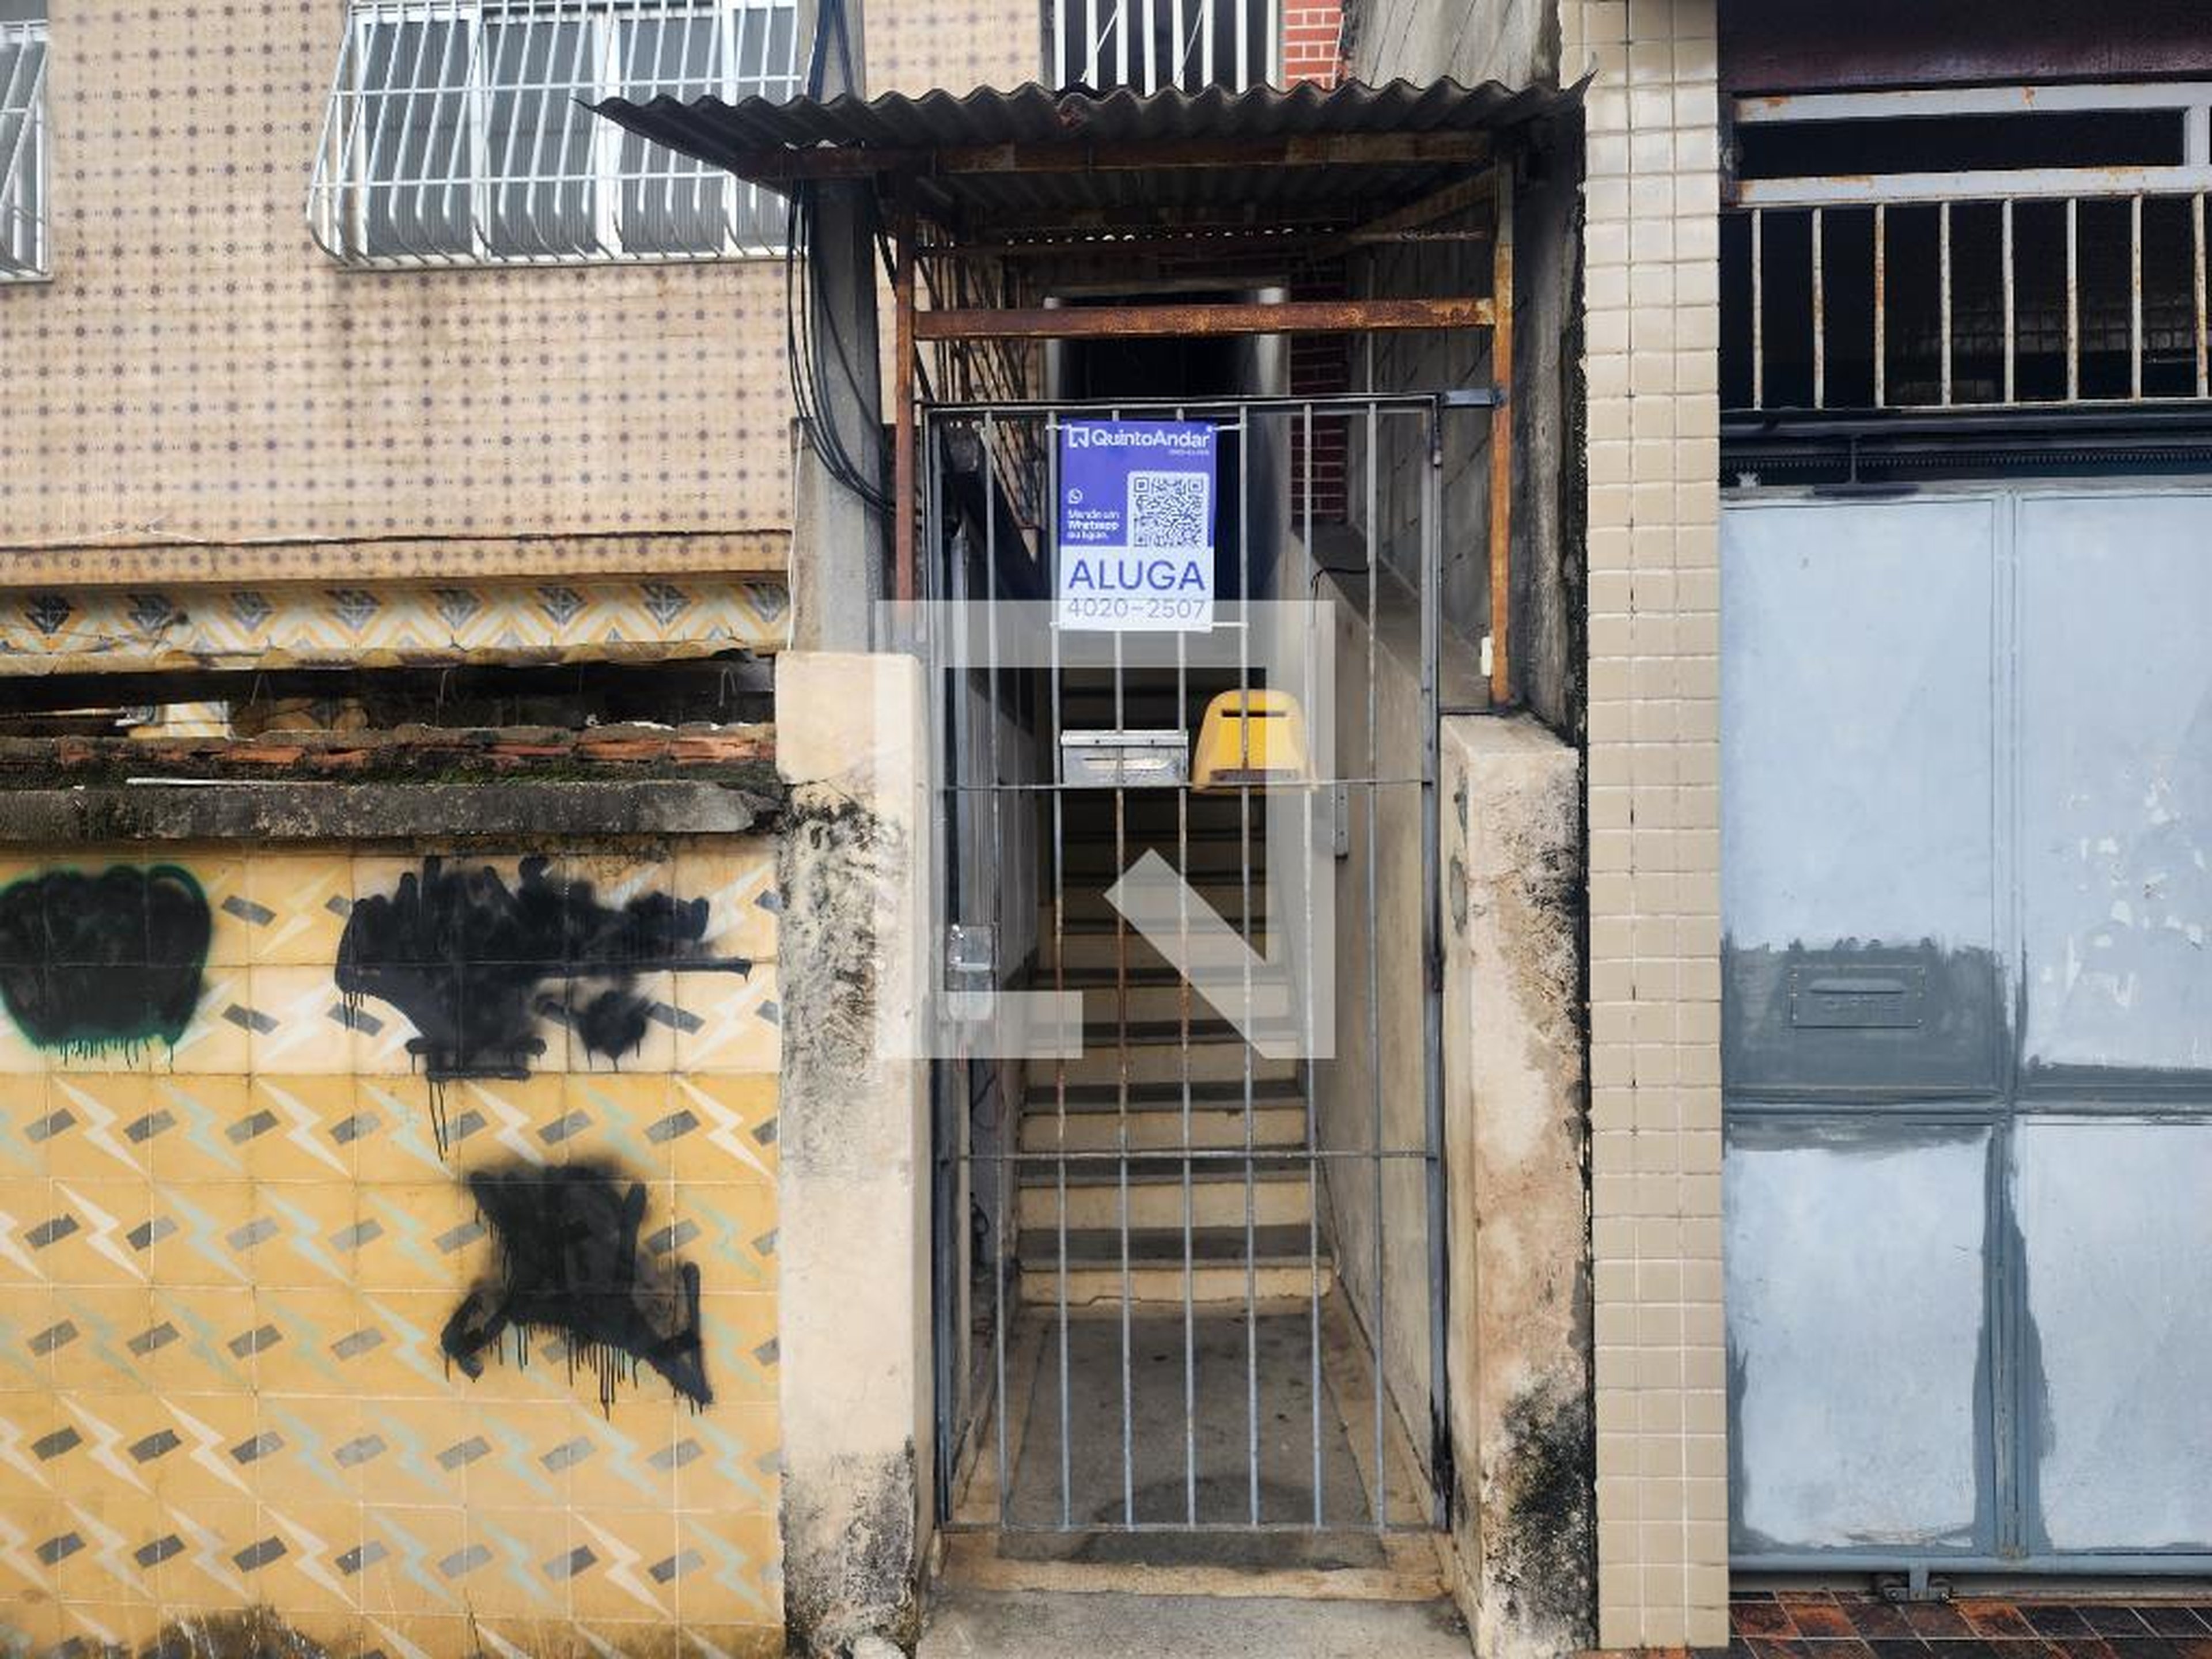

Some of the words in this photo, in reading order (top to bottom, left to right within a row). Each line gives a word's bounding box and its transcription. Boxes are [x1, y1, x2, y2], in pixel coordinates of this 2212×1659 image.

[1091, 429, 1210, 448] QuintoAndar
[1069, 559, 1206, 590] ALUGA
[1069, 597, 1206, 620] 4020-2507
